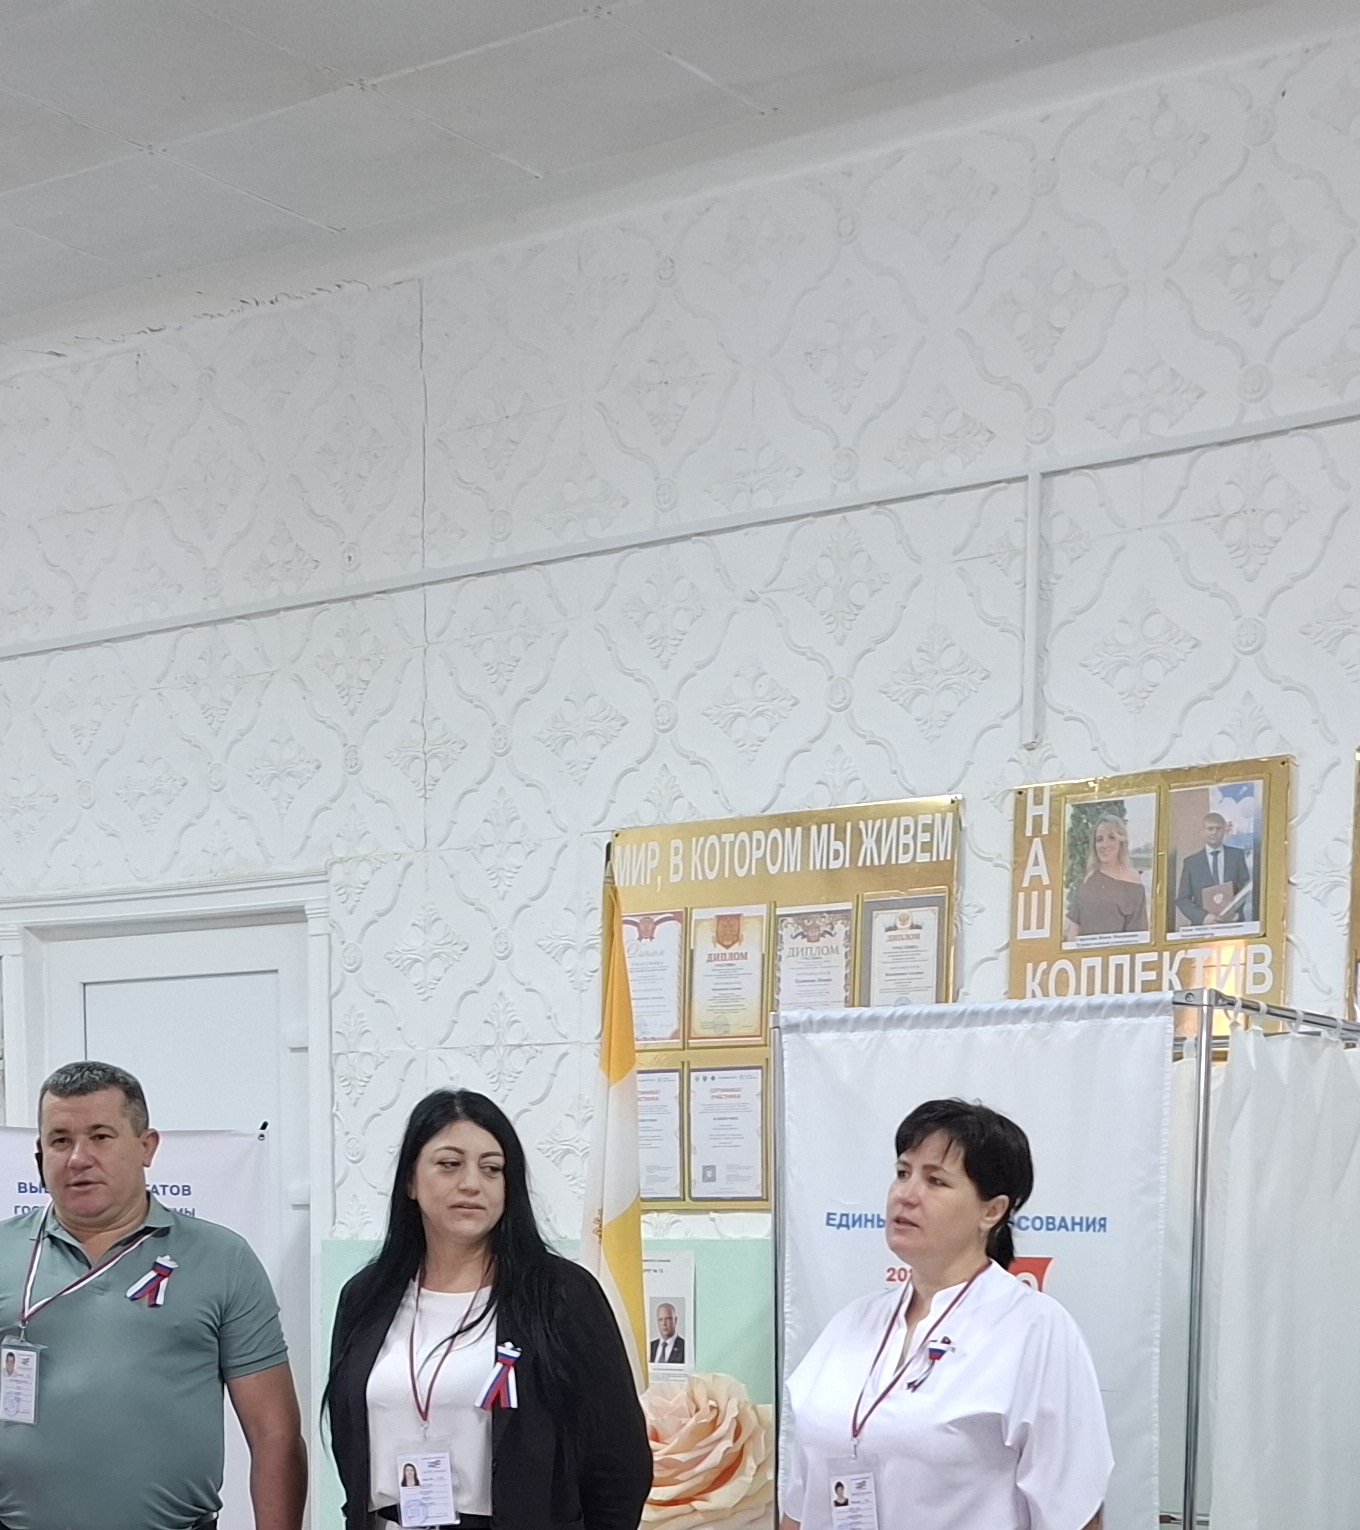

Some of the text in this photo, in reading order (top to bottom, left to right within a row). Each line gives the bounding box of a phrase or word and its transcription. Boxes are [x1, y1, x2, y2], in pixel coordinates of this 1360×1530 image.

[613, 812, 954, 893] МИР, В КОТОРОМ МЫ ЖИВЕМ
[706, 952, 749, 963] ДИПЛОМ
[786, 945, 840, 958] ДИПЛОМ
[146, 1184, 192, 1196] АТОВ
[825, 1211, 1108, 1233] ЕДИНЫ СОВАНИЯ
